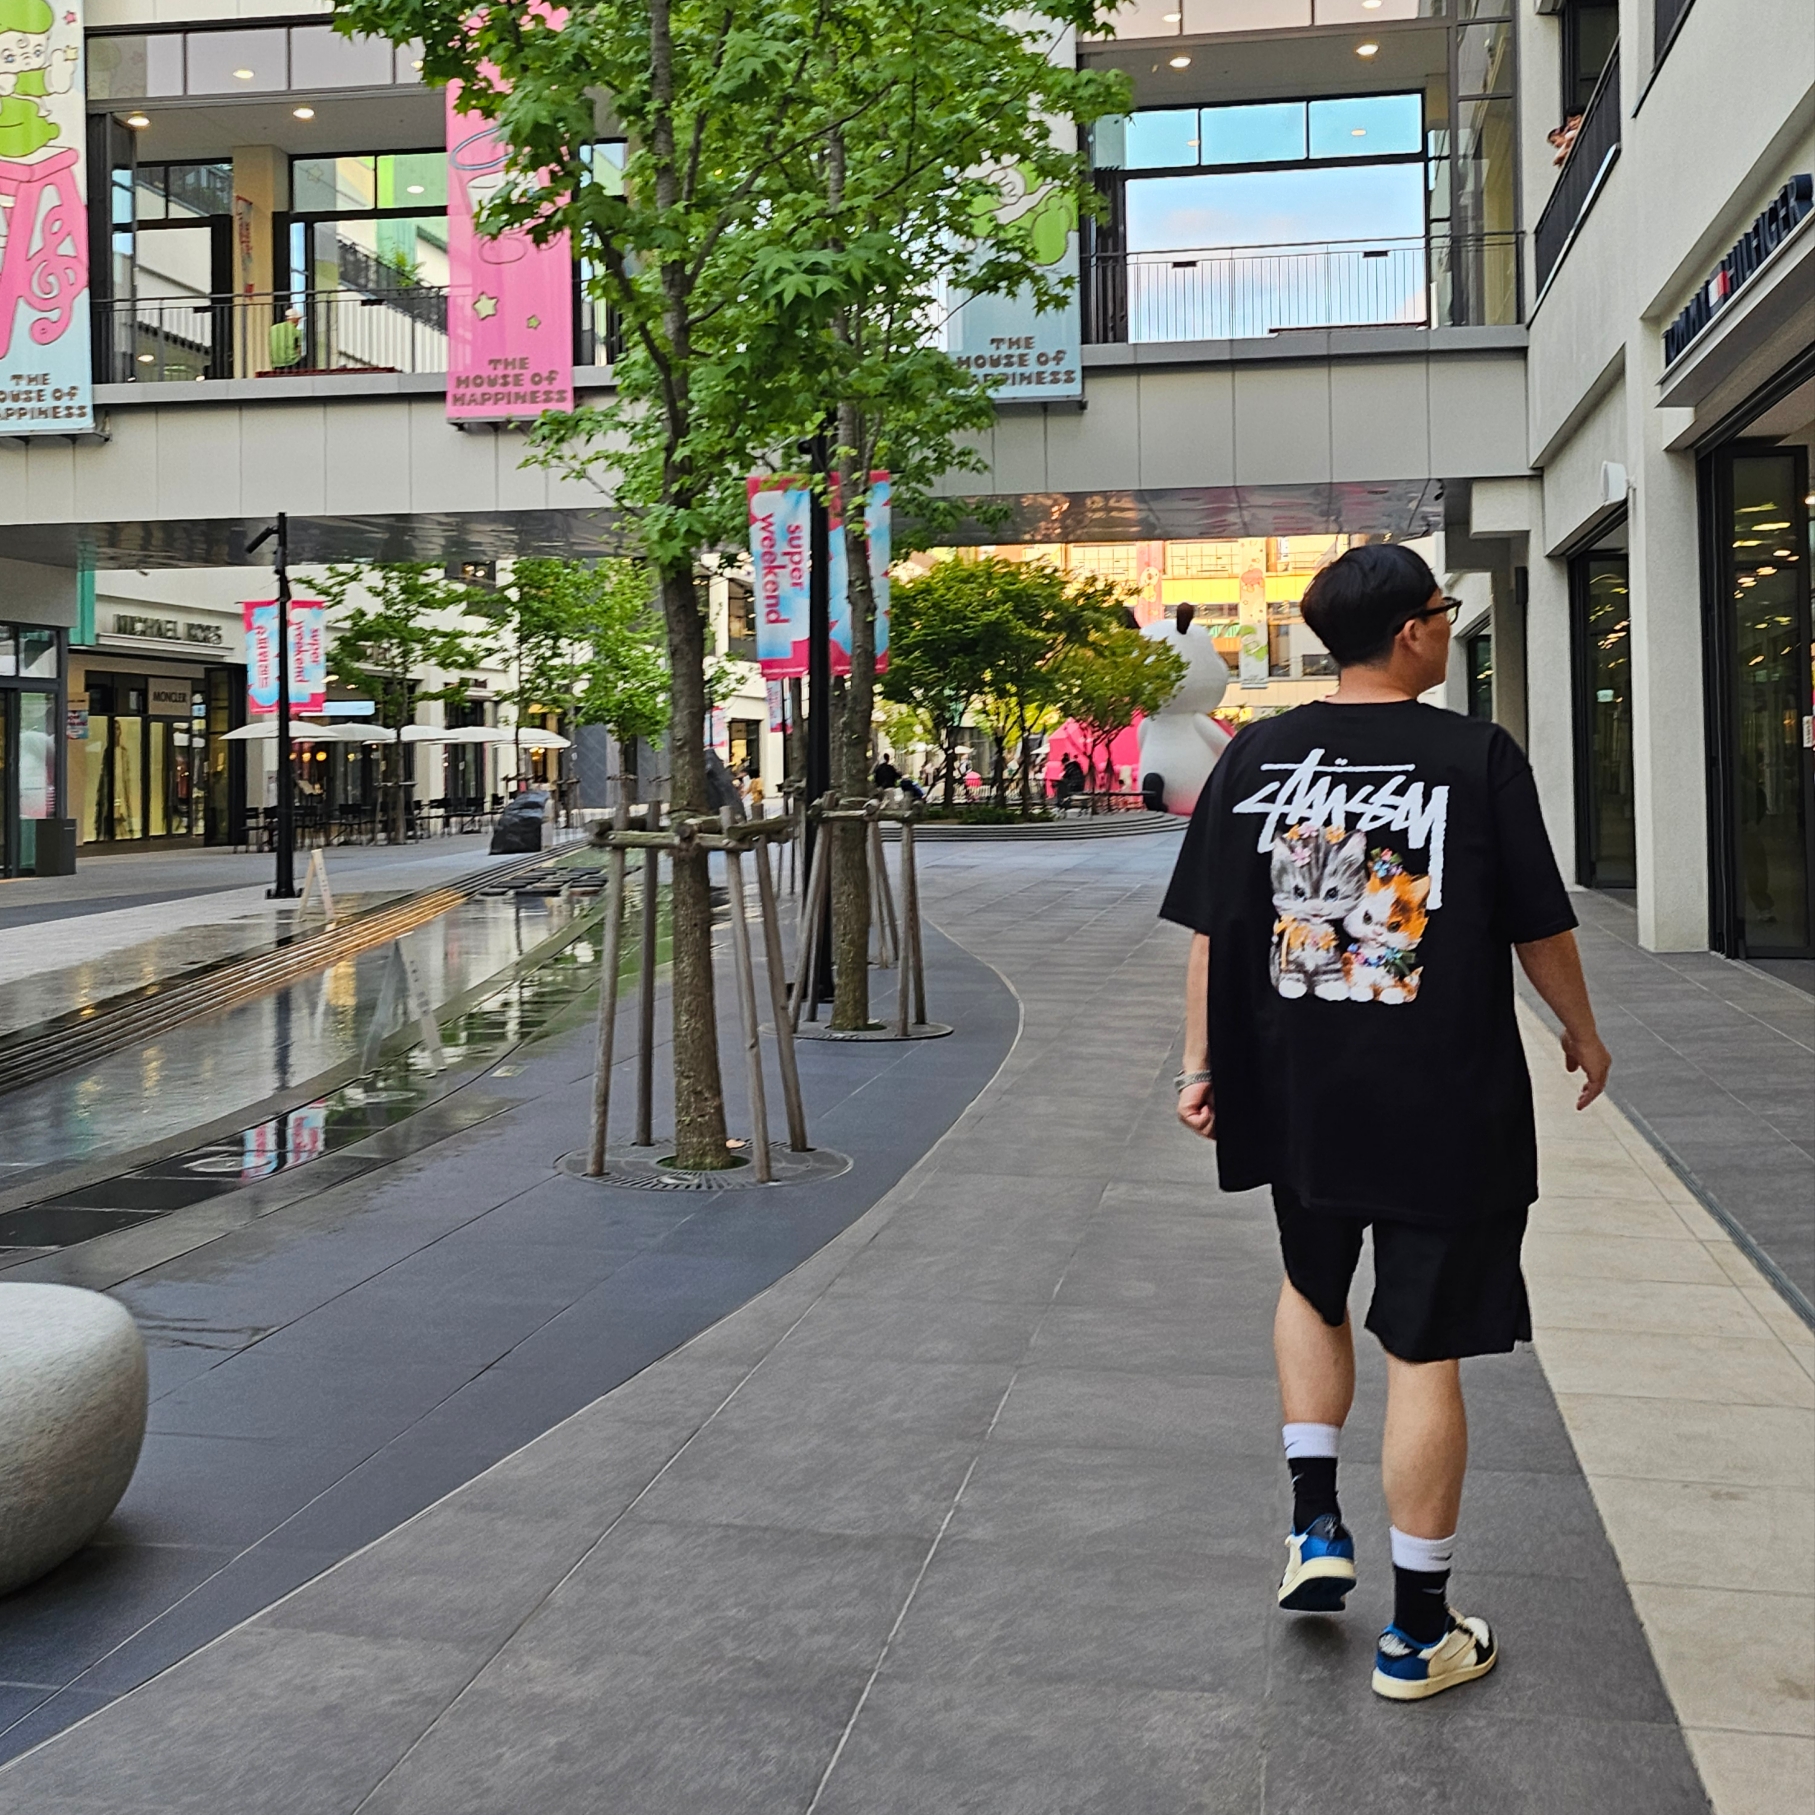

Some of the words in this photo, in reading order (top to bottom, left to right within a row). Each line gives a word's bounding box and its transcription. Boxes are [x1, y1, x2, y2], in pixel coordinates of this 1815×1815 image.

[989, 336, 1035, 350] THE
[487, 357, 530, 370] THE
[956, 353, 1030, 369] HOUSE
[10, 373, 51, 386] THE
[455, 373, 525, 389] HOUSE
[0, 388, 46, 403] OUSE
[451, 389, 568, 407] HAPPINESS
[781, 523, 804, 591] super
[758, 512, 792, 625] weekend
